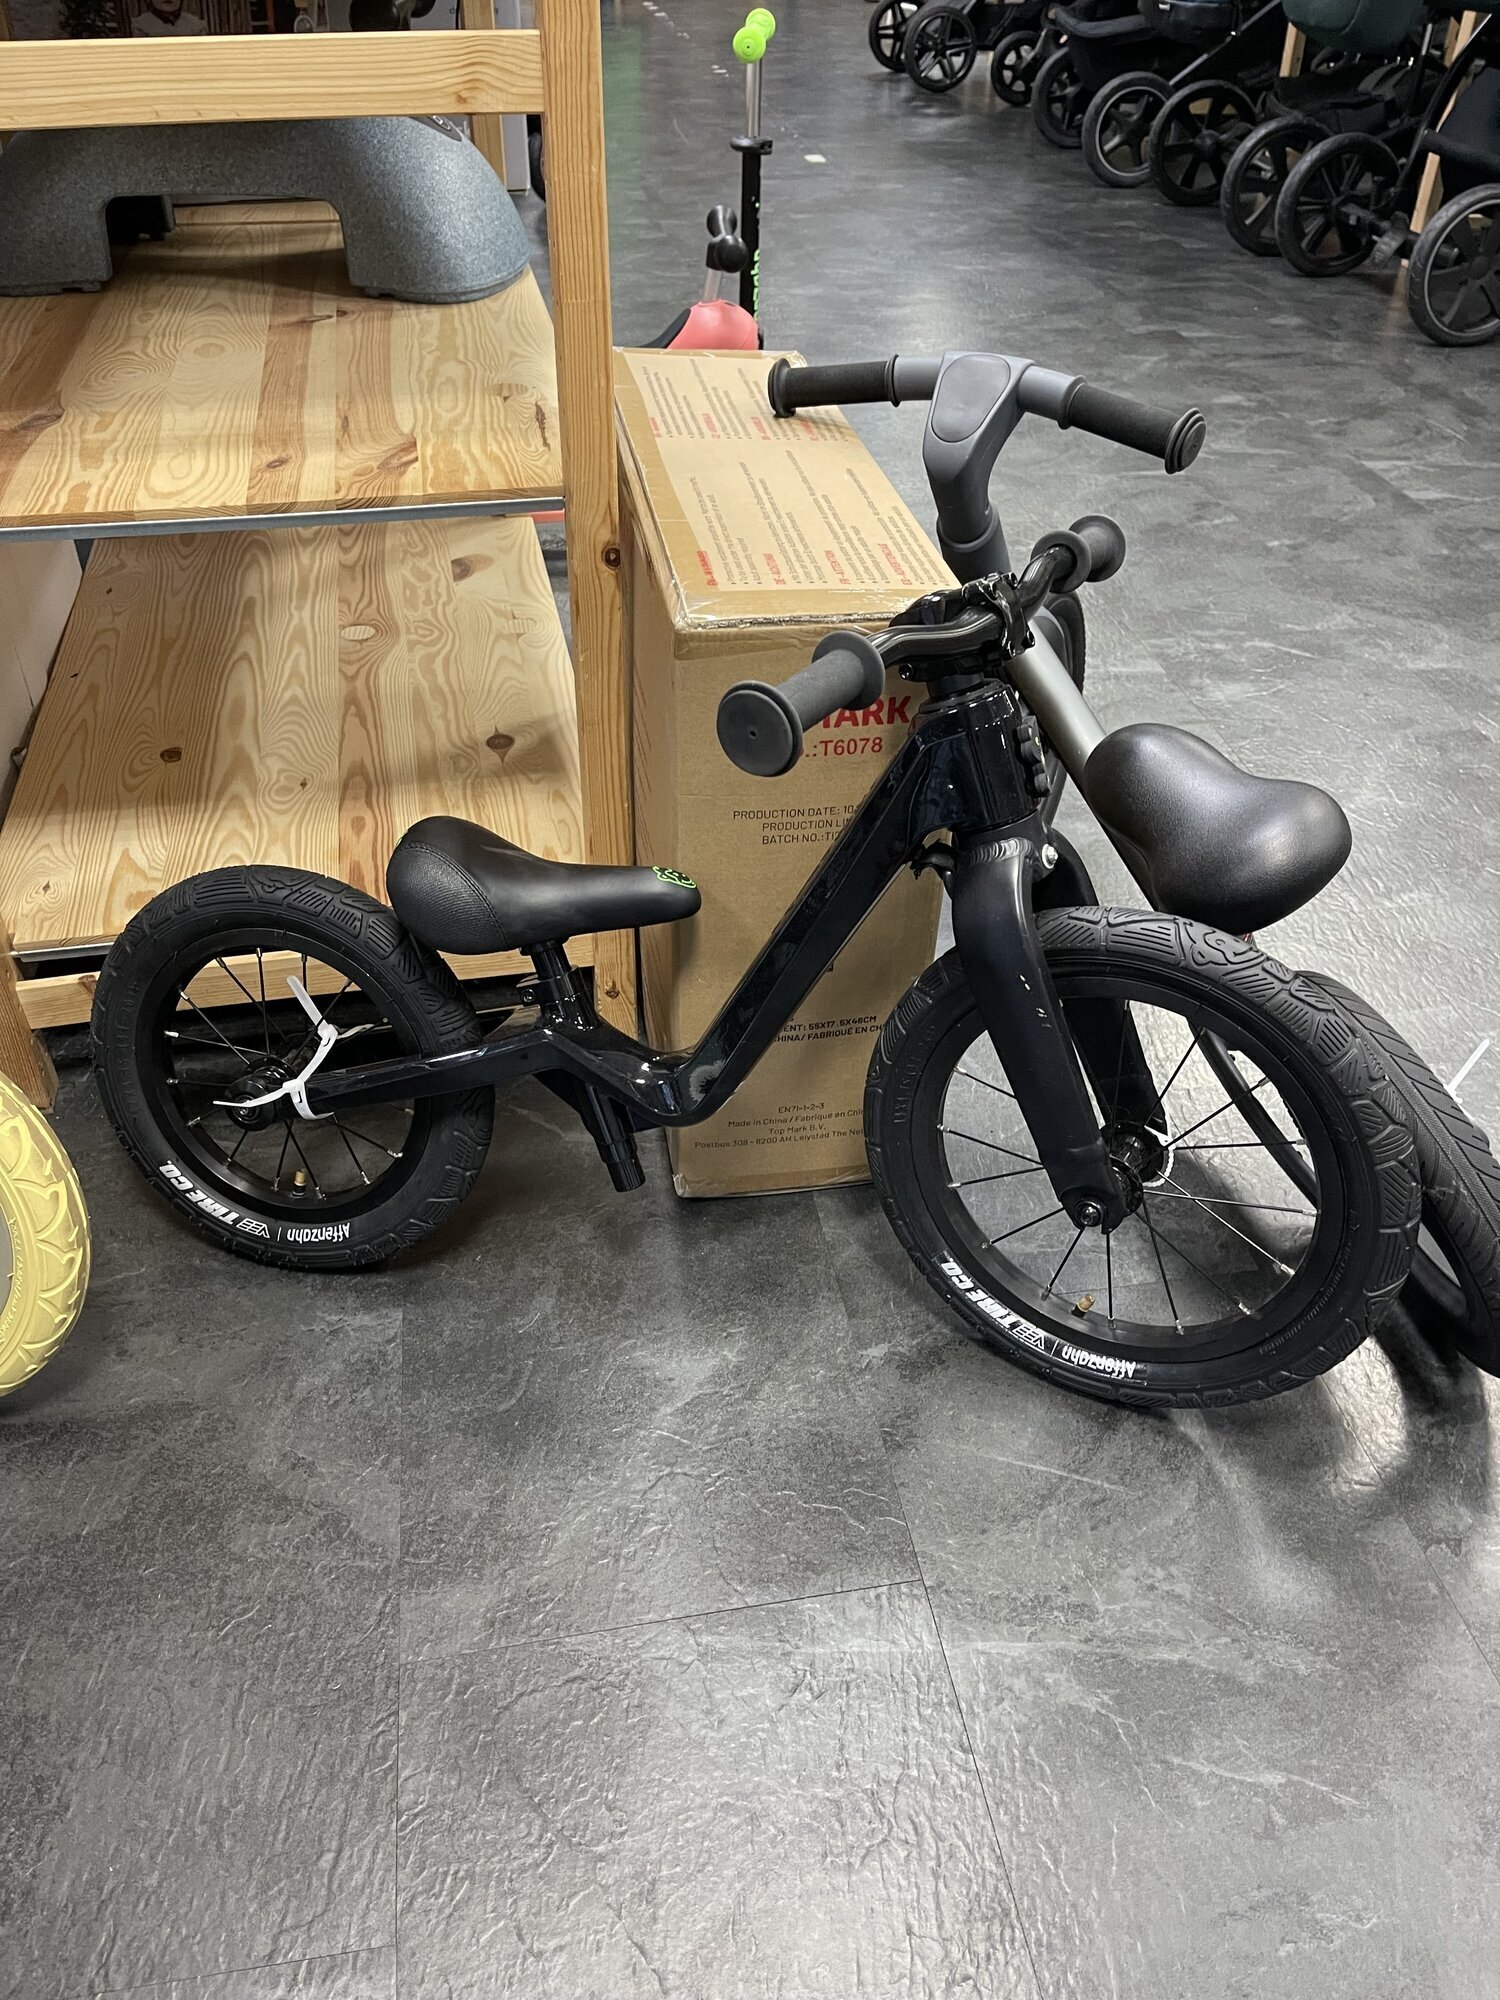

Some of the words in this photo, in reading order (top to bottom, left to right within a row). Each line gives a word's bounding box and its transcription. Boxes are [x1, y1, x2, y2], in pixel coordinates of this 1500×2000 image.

[823, 696, 911, 728] ARK
[733, 808, 805, 819] PRODUCTION
[807, 806, 840, 817] DATE:
[762, 819, 832, 831] PRODUCTION
[762, 834, 799, 844] BATCH
[775, 1034, 805, 1042] HINA/
[855, 1026, 867, 1034] EN
[783, 1024, 806, 1032] ENT:
[728, 1120, 751, 1128] Made
[763, 1117, 788, 1125] China
[159, 1160, 194, 1191] CO.
[185, 1189, 240, 1225] TIRE
[287, 1222, 350, 1244] Affenzahn
[965, 1288, 1020, 1328] TIRE
[1061, 1343, 1137, 1378] Affenzahn
